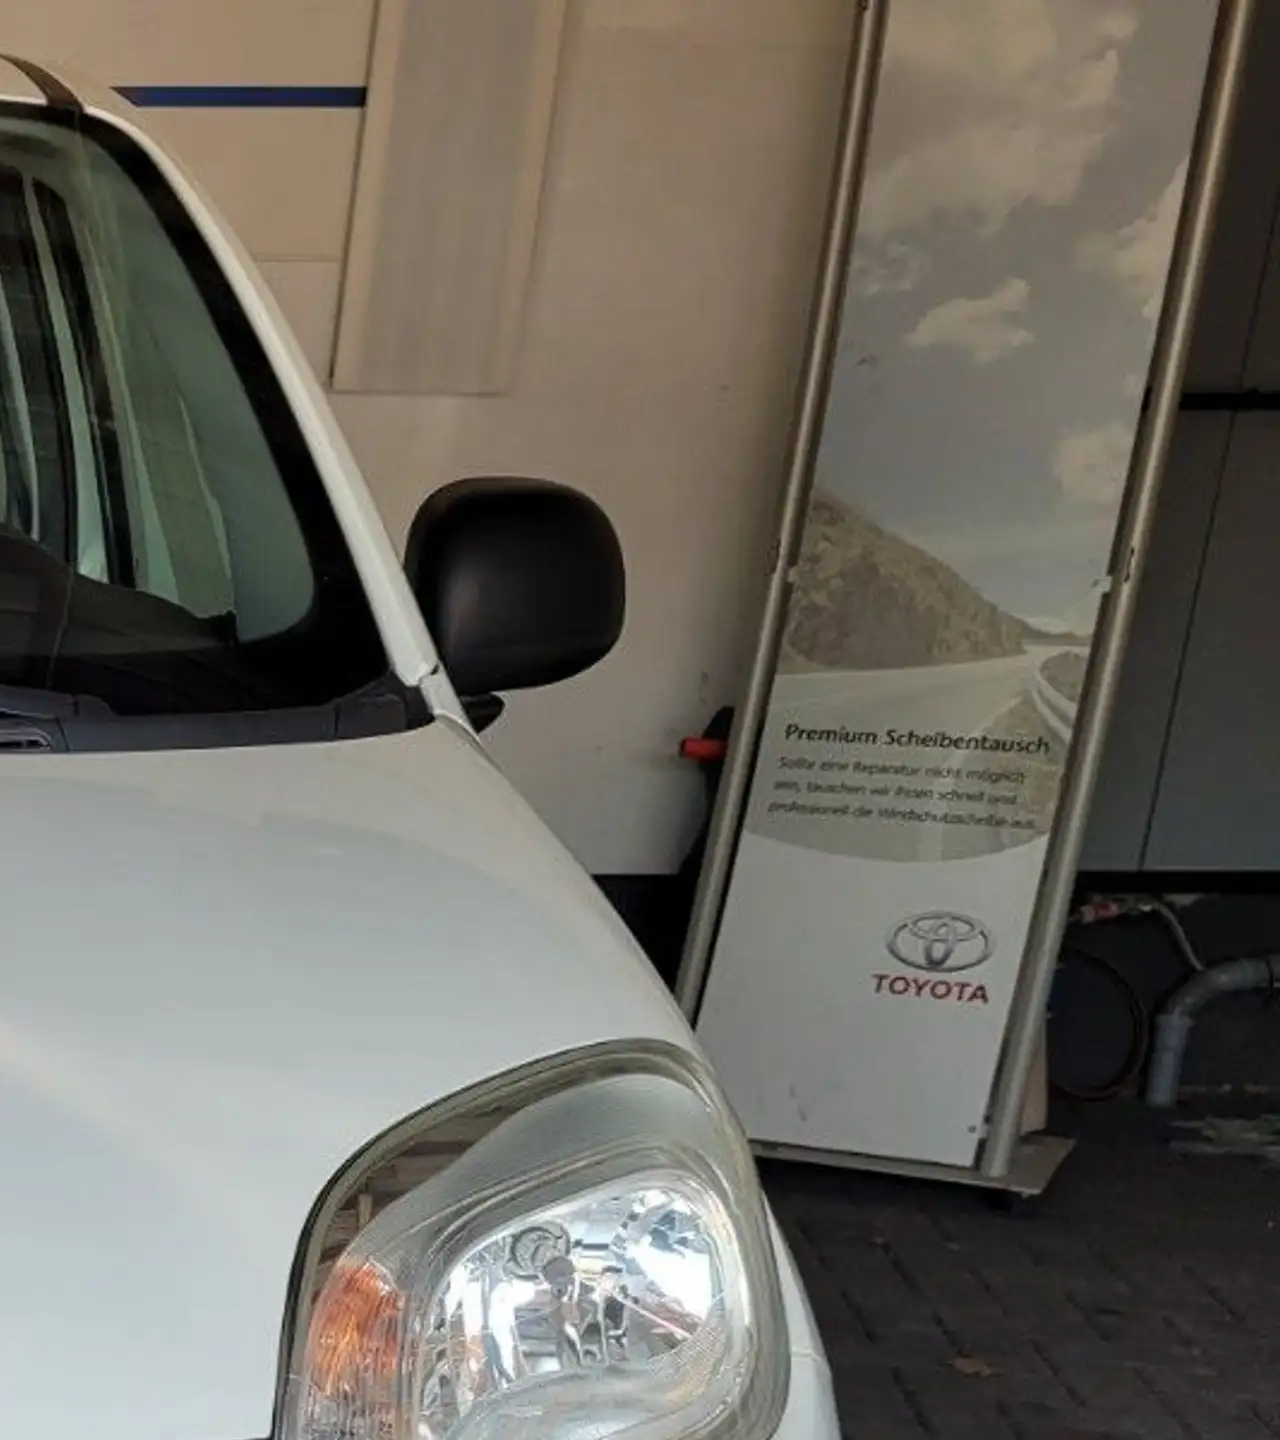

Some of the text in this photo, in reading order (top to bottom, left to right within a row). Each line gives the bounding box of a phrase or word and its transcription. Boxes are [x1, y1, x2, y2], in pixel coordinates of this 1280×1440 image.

[784, 724, 1051, 755] Premium Scheibentausch
[871, 973, 990, 1004] TOYOTA
